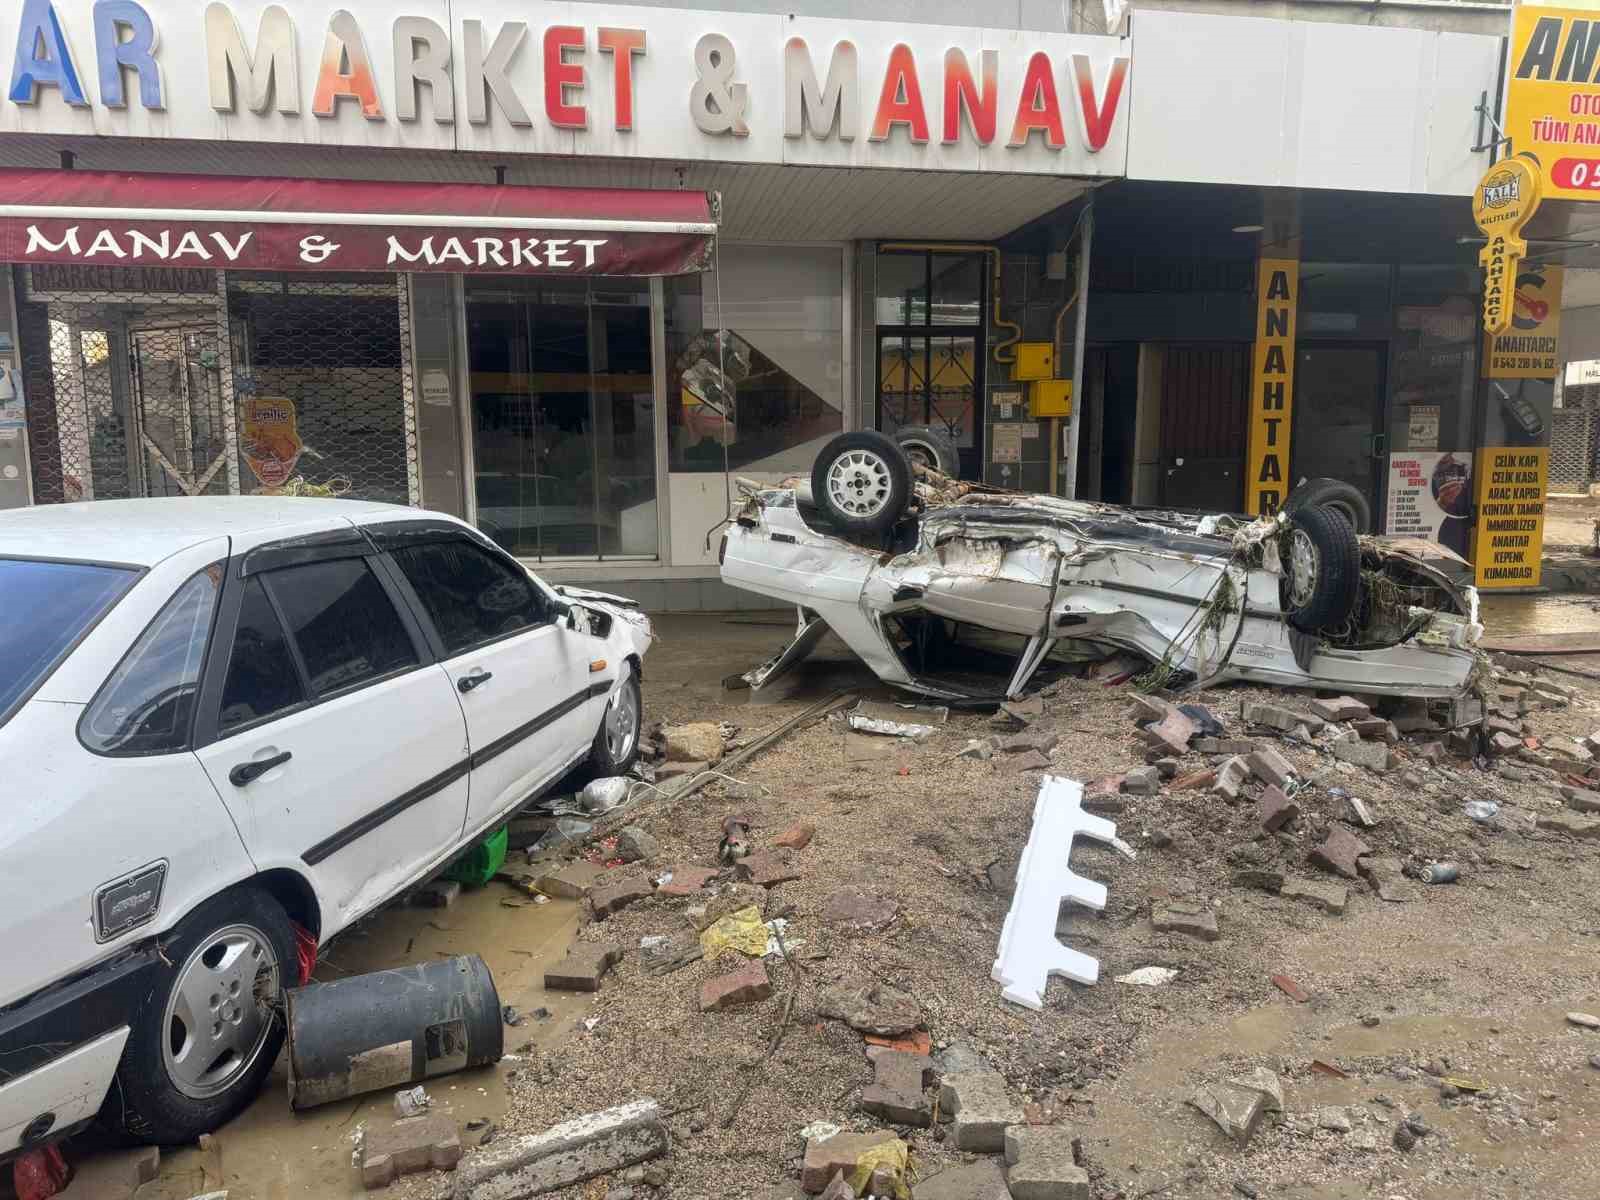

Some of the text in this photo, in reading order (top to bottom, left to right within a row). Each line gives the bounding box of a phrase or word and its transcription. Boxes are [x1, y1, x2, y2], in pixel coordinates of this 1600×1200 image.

[1514, 16, 1600, 84] AN
[8, 0, 1130, 152] AR MARKET & MANAV
[1531, 115, 1600, 144] TÜM AN
[1484, 183, 1517, 204] KALE
[25, 224, 610, 268] MANAV & MARKET
[1487, 236, 1505, 326] ANAHTARCI
[1494, 335, 1556, 353] ANAHTARCI
[1518, 455, 1538, 467] KAPI
[1515, 471, 1538, 483] KASA
[1482, 503, 1514, 516] KONTAK
[1491, 535, 1530, 548] ANAHTAR
[1494, 551, 1525, 563] KEPENK
[1483, 567, 1533, 579] KUMANDASI
